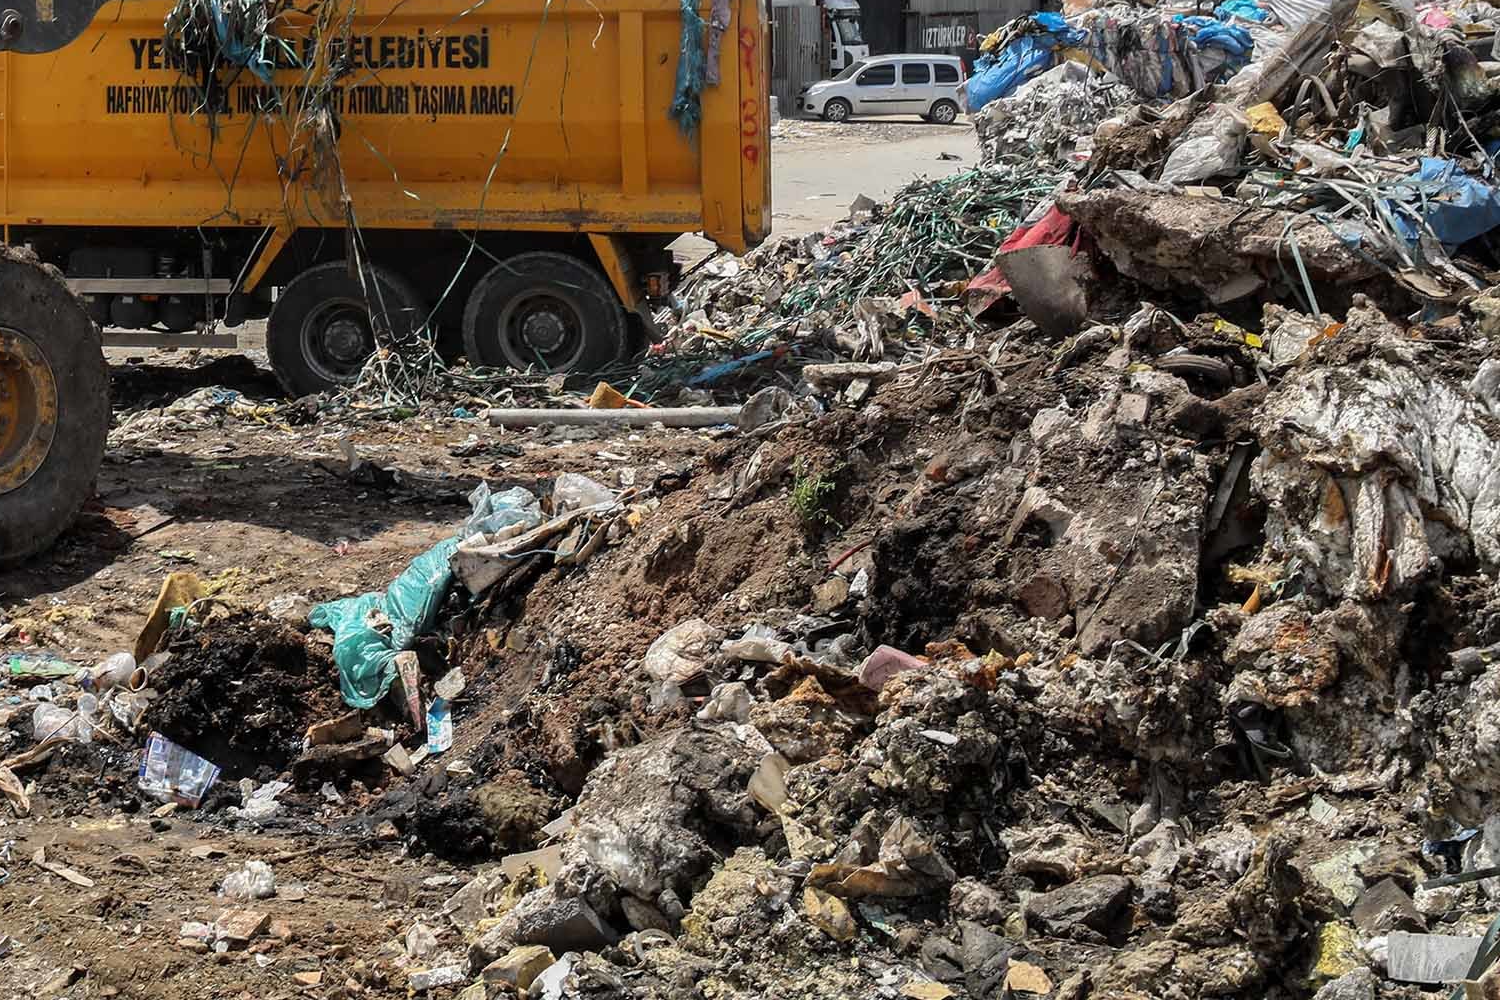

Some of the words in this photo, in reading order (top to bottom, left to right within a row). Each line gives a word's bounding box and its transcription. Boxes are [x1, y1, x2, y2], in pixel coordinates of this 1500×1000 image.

[328, 28, 489, 69] ELEDİYESİ
[106, 80, 168, 114] HAFRİYAT
[348, 85, 409, 114] ATIKLARI
[414, 85, 466, 122] TAŞIMA
[470, 85, 515, 115] ARACI
